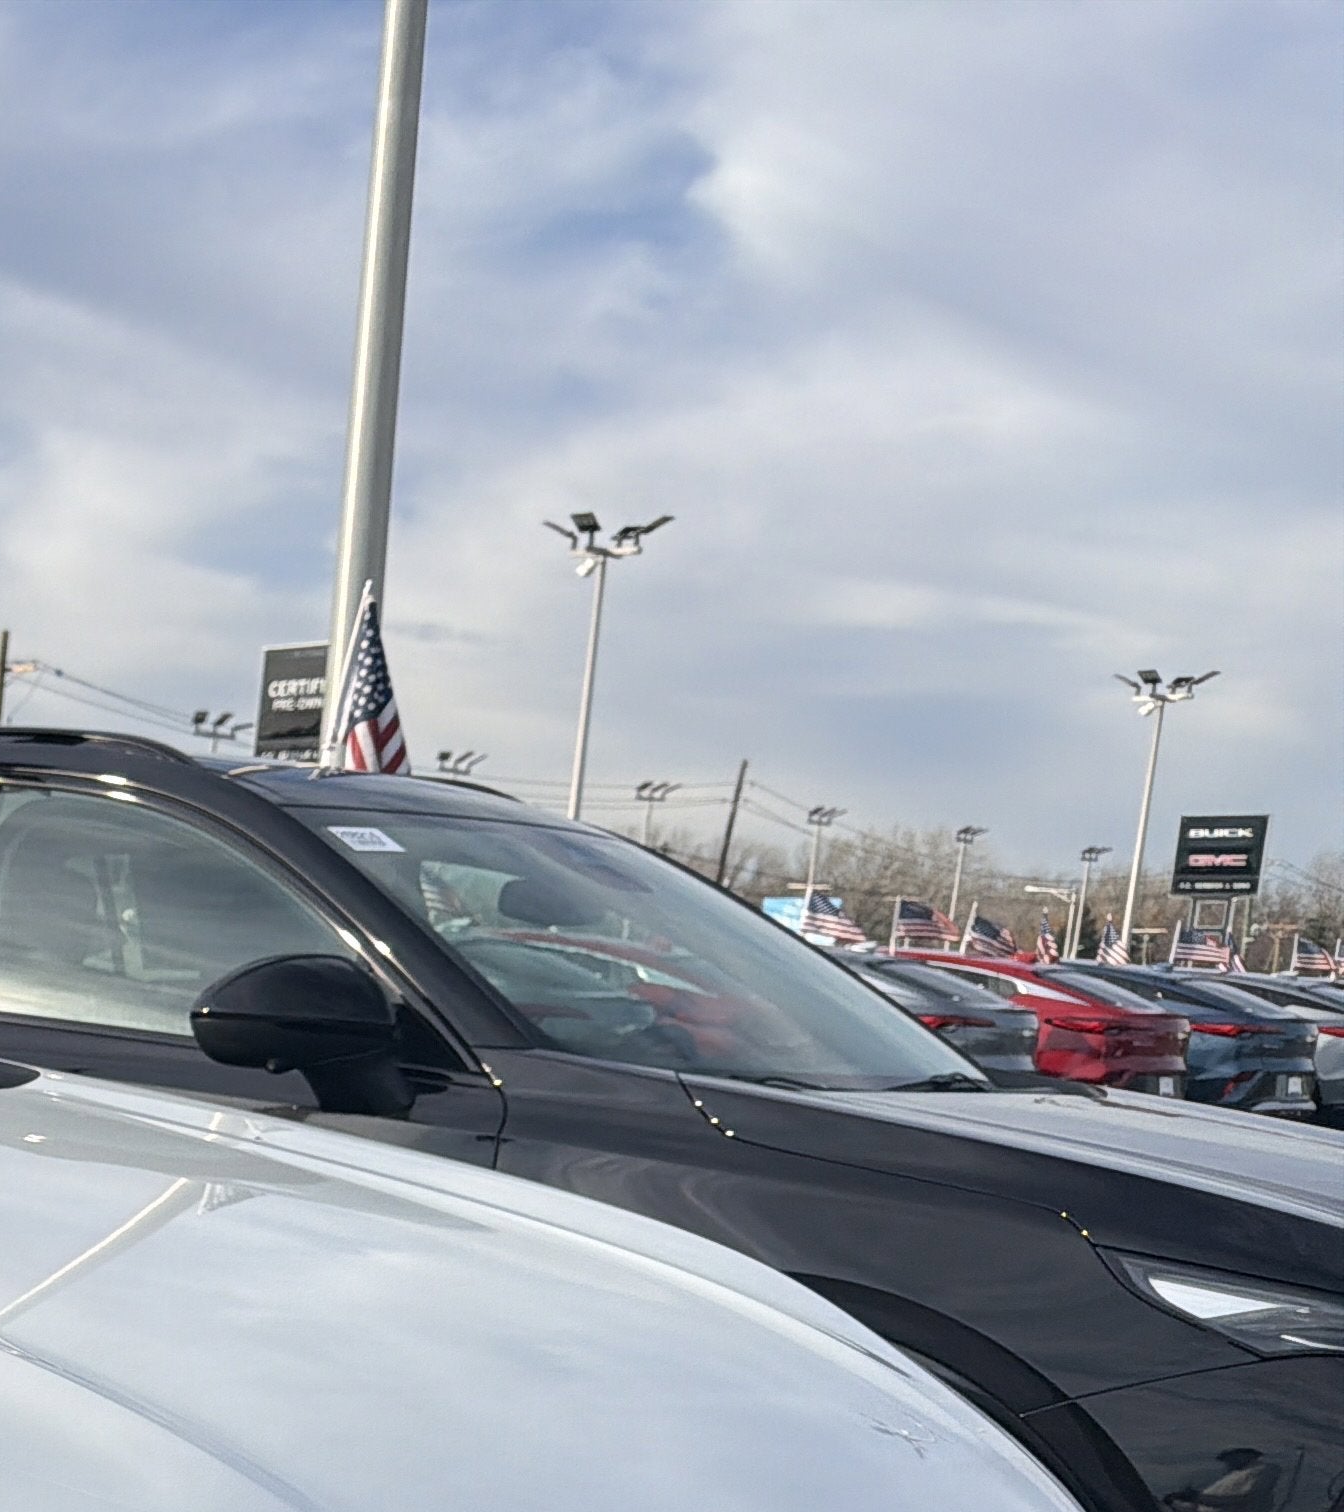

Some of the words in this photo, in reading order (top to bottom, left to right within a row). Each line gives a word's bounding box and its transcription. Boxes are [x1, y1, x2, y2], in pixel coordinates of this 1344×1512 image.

[267, 676, 327, 698] CERTIFI
[1188, 827, 1254, 839] BUICK
[1188, 853, 1248, 867] GMC
